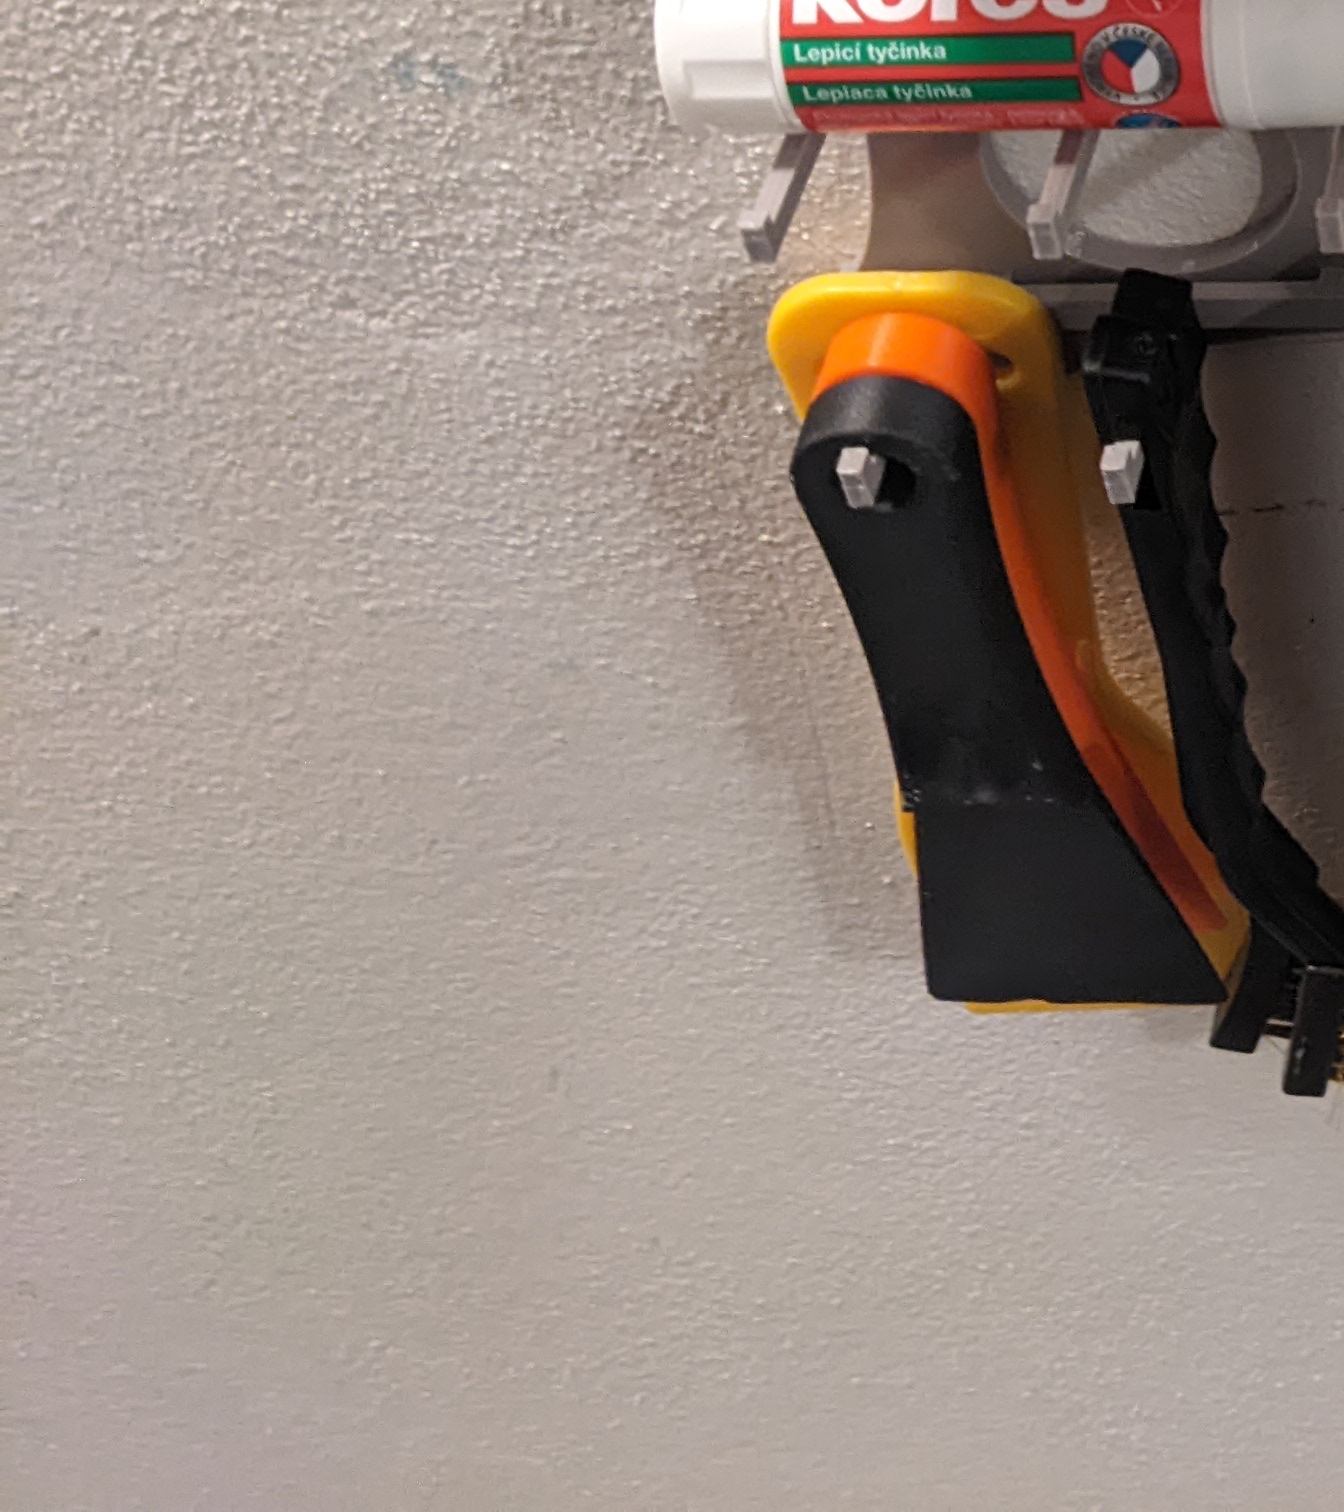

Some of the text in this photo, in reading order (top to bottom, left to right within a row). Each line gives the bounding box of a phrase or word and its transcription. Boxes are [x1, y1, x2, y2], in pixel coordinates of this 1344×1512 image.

[793, 40, 947, 66] Lepicí tyčinka
[893, 83, 973, 104] tyčinka
